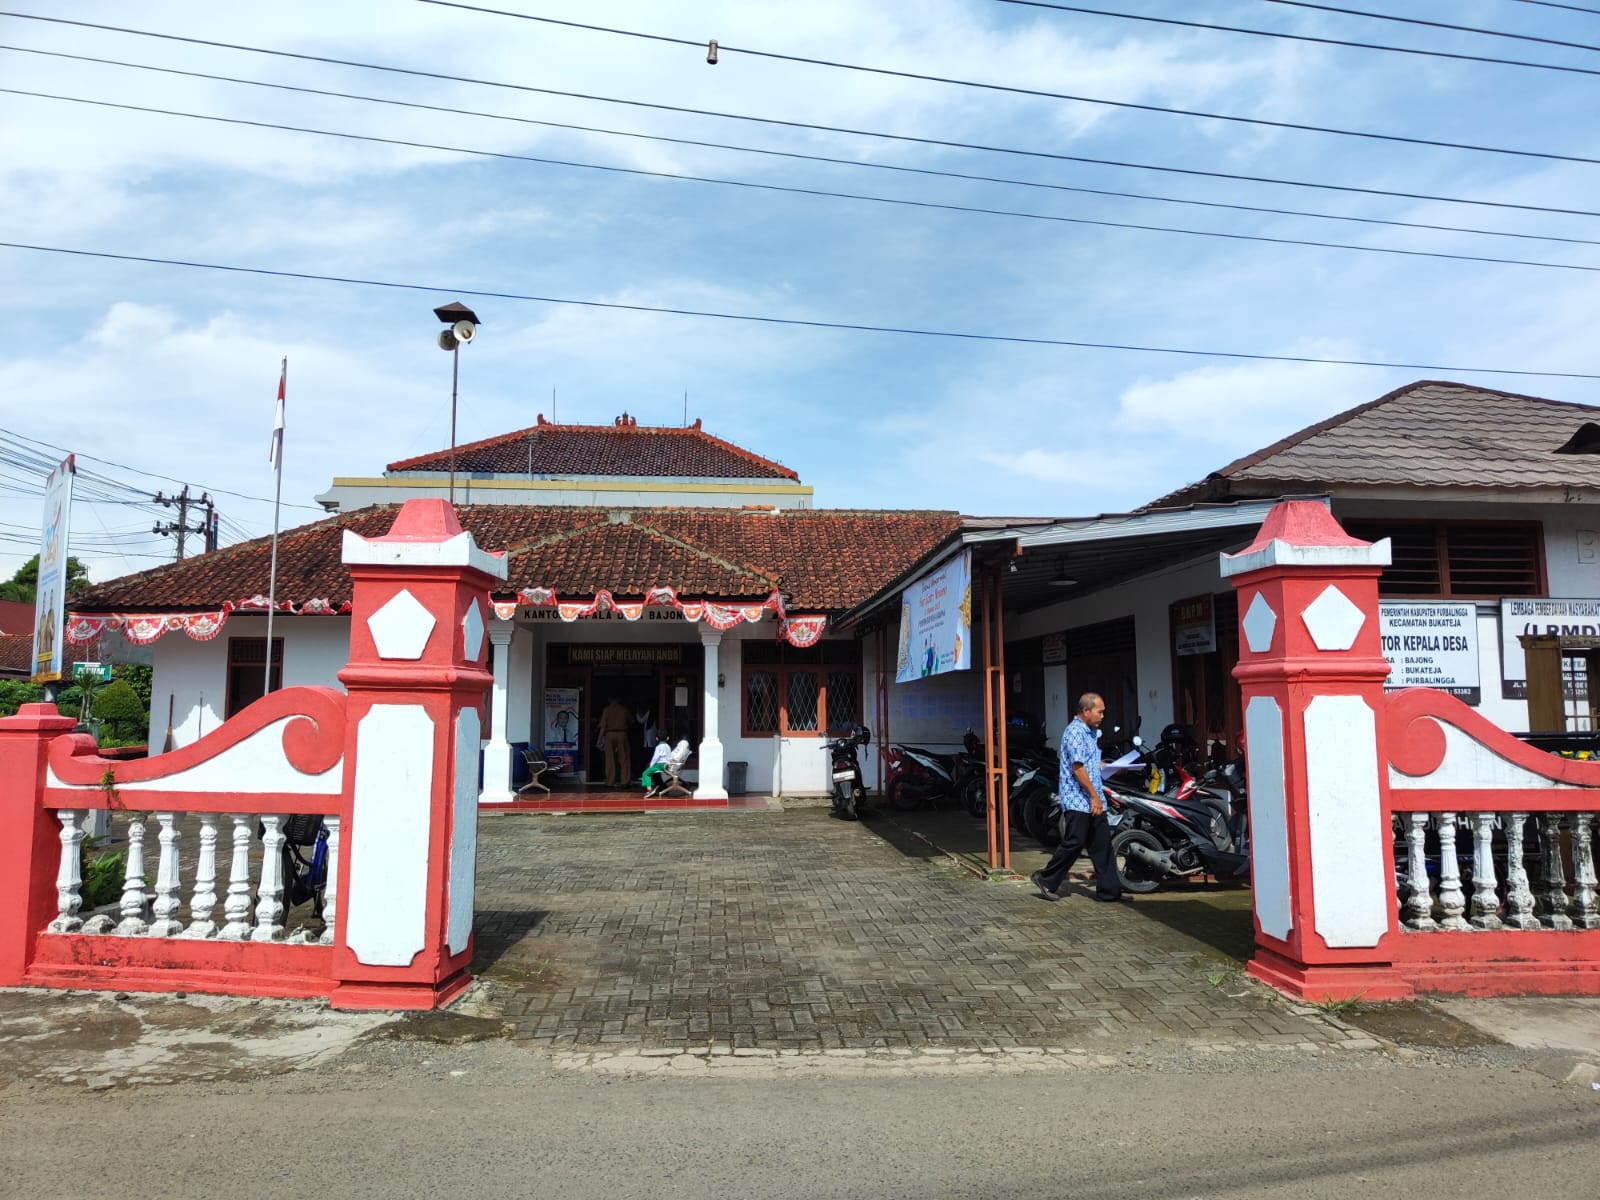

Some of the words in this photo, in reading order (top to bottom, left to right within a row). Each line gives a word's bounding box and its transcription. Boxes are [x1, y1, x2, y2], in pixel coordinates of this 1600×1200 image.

[1381, 608, 1410, 617] PEMERINTAH
[1410, 608, 1436, 617] KABUPATEN
[1437, 608, 1468, 617] PURBALINGGA
[1511, 602, 1534, 616] LEMBAGA
[524, 610, 561, 619] KANTO
[649, 611, 684, 620] BAJON
[1389, 618, 1427, 627] KECAMATAN
[1429, 618, 1461, 627] BUKATEJA
[1381, 635, 1401, 651] TOR
[1403, 635, 1440, 651] KEPALA
[1443, 635, 1468, 651] DESA
[572, 647, 593, 661] KAMI
[595, 647, 615, 661] SIAP
[616, 647, 655, 661] MELAYANI
[656, 647, 679, 661] ANDA
[1385, 656, 1395, 664] SA
[1404, 656, 1434, 664] BAJONG
